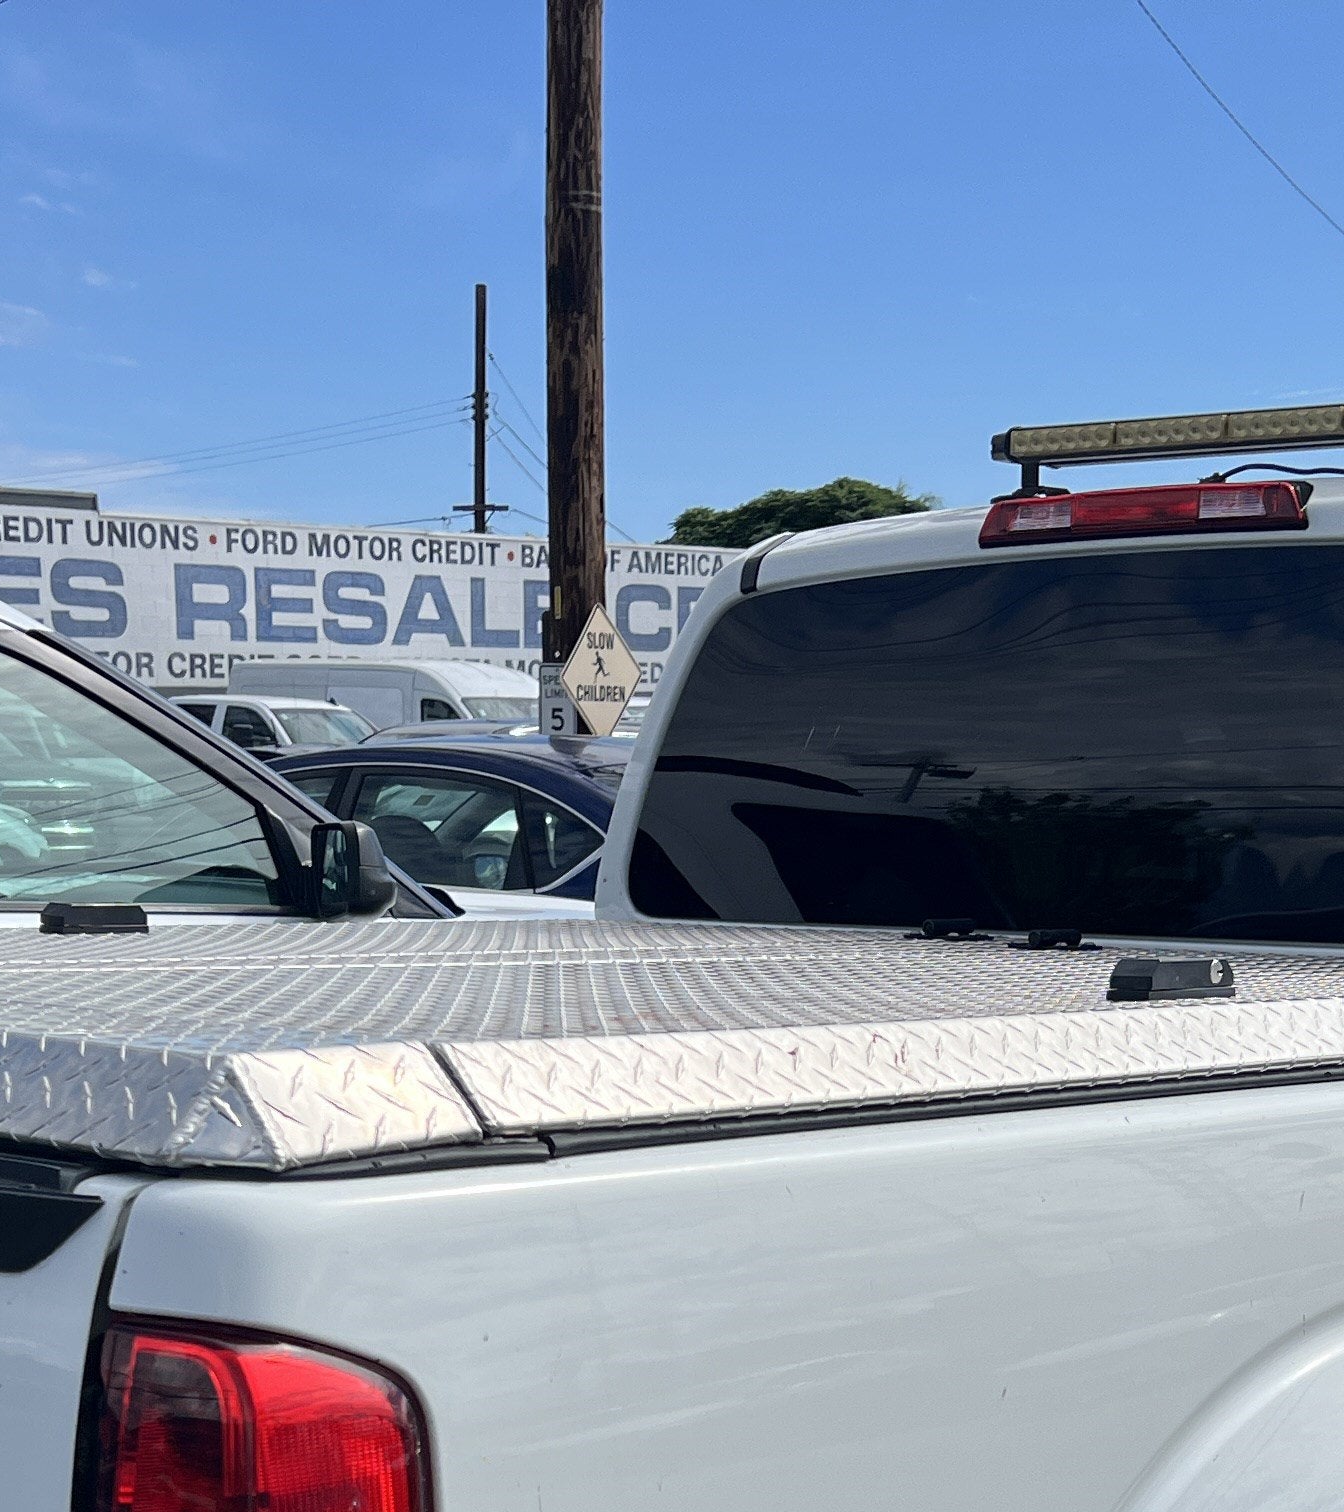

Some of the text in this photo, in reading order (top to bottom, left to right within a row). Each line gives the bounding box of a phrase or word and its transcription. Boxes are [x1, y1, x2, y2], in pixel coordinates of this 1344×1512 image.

[85, 519, 199, 551] UNIONS
[226, 527, 297, 556] FORD
[308, 533, 402, 562] MOTOR
[411, 538, 501, 568] CREDIT
[521, 544, 550, 569] BA
[627, 551, 724, 577] AMERICA
[586, 632, 615, 650] SLOW
[543, 674, 561, 685] SPE
[576, 684, 626, 702] CHILDREN
[551, 707, 565, 731] 5
